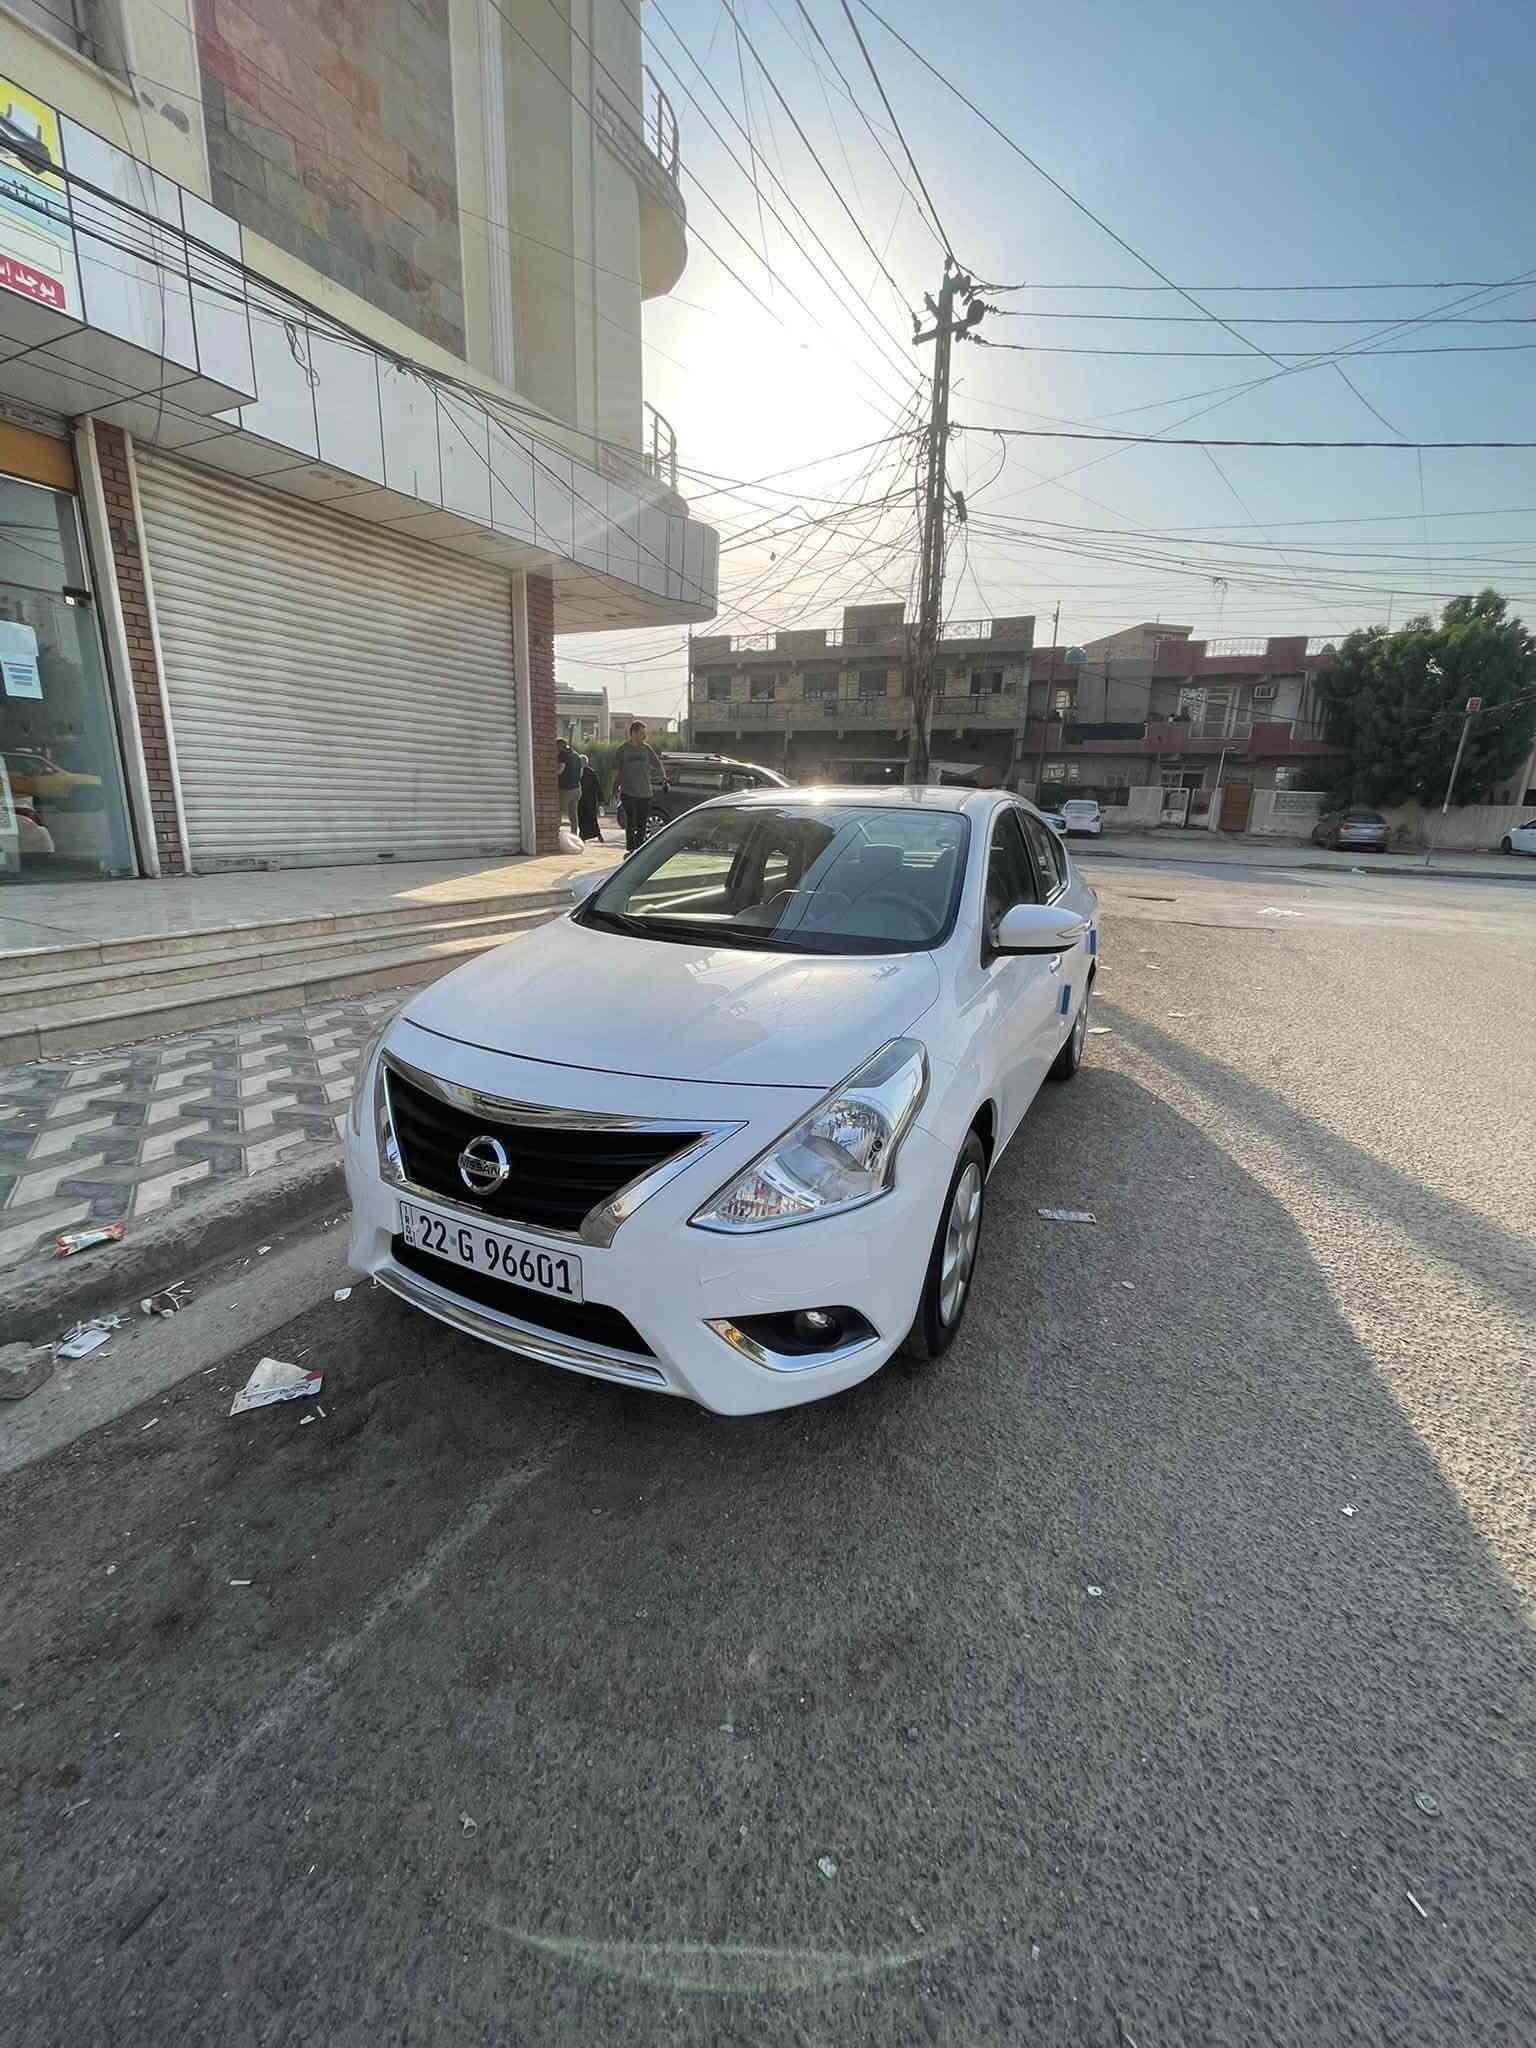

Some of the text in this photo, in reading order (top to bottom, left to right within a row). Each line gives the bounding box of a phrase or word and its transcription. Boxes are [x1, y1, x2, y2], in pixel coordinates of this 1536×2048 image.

[15, 269, 57, 304] يوجد
[419, 1215, 448, 1254] 22
[458, 1229, 474, 1264] G
[485, 1238, 573, 1294] 96601
